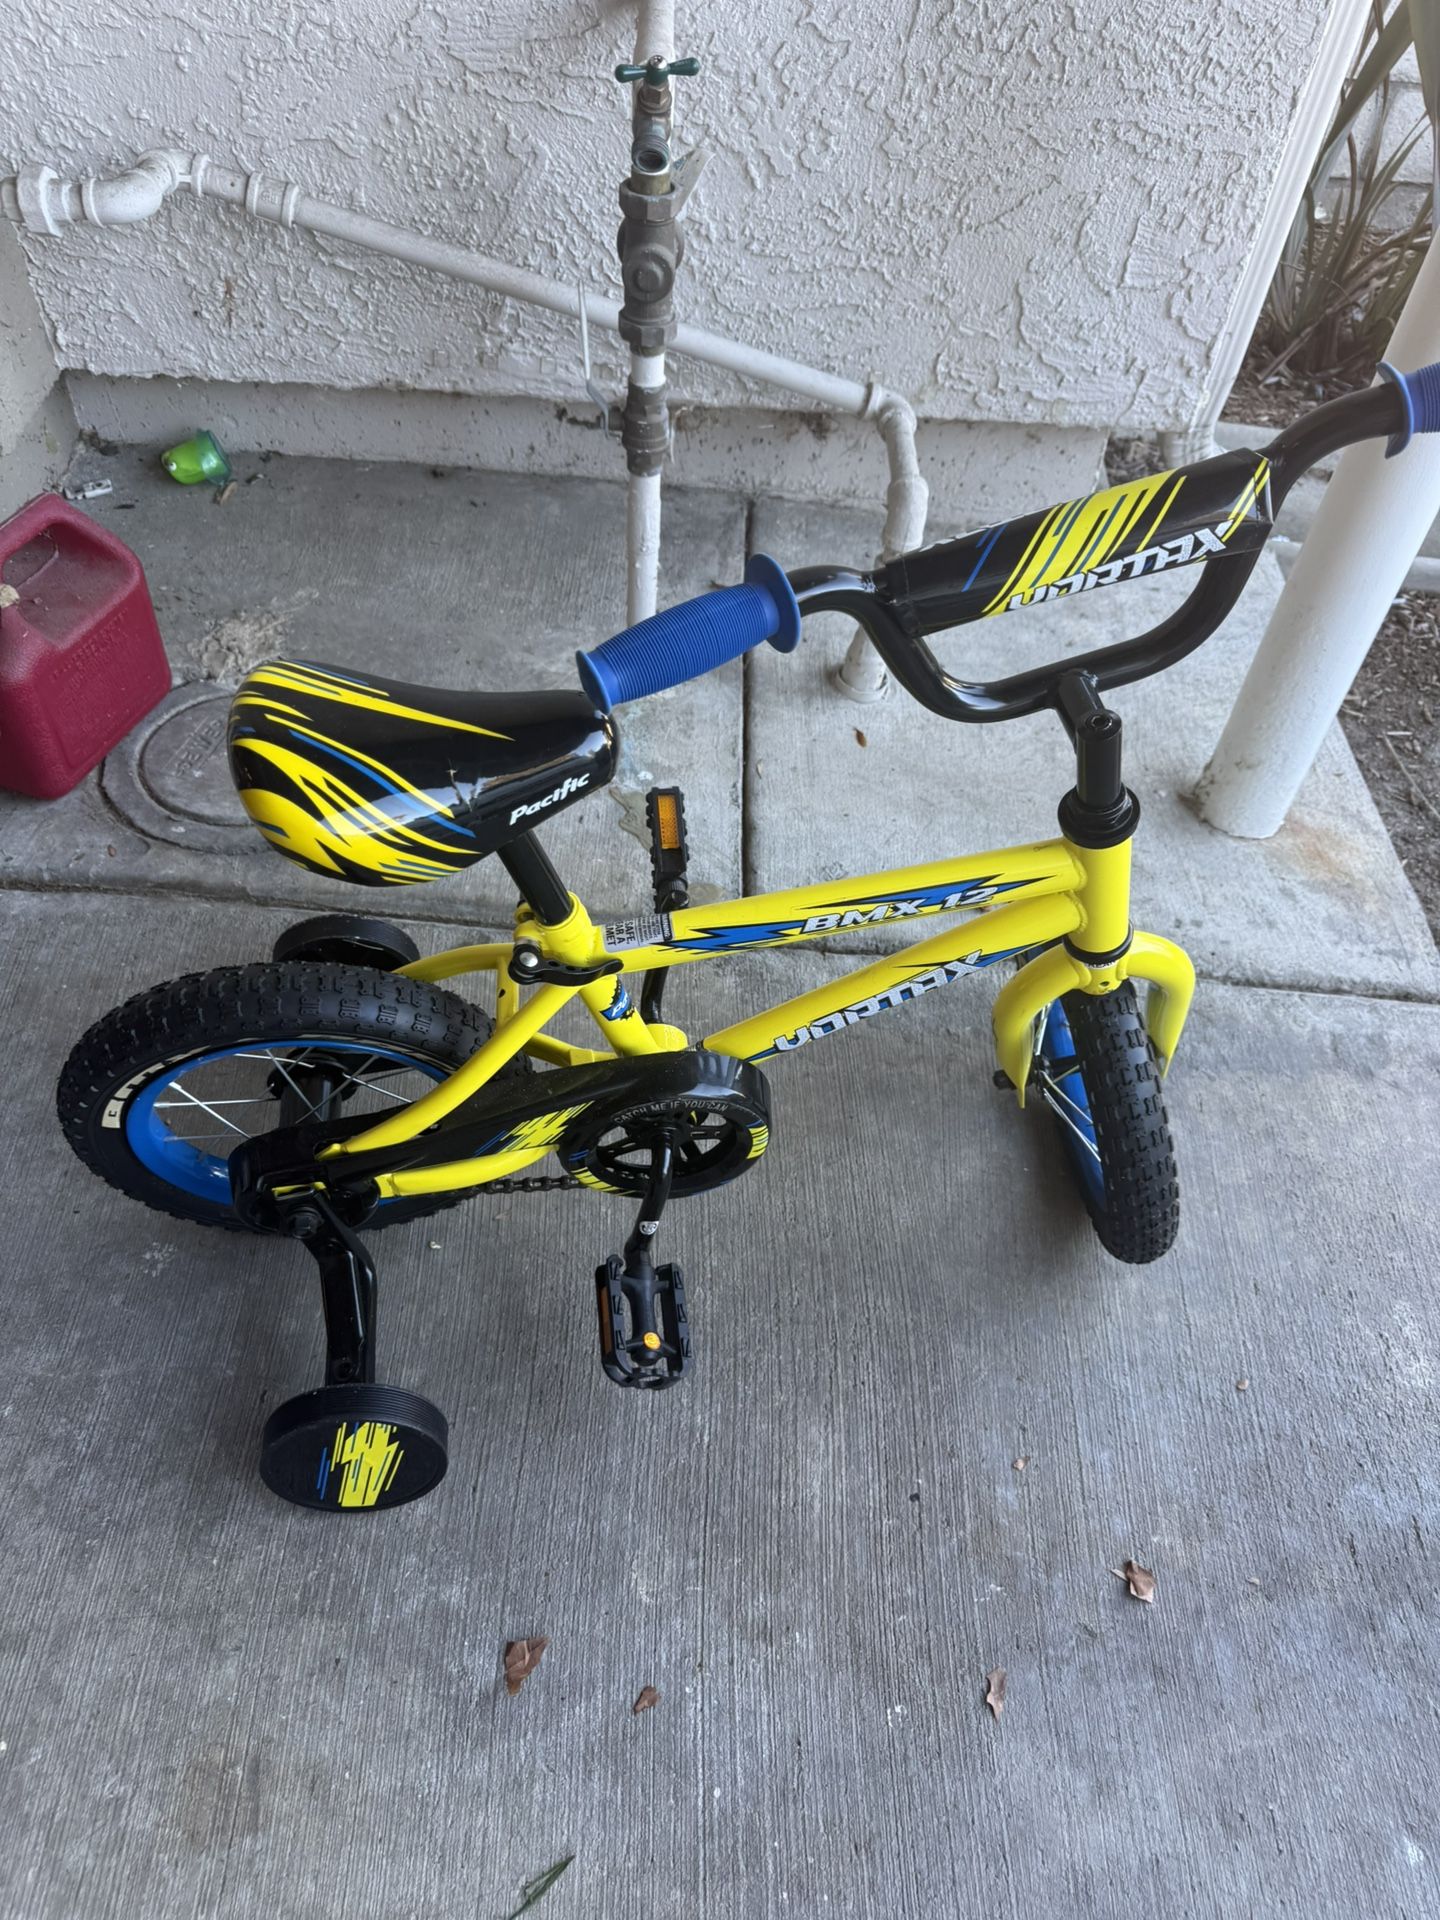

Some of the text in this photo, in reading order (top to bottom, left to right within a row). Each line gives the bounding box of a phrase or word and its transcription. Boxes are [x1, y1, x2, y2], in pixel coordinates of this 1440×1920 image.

[509, 773, 590, 826] Pacific
[803, 887, 998, 933] BMX 12
[614, 1101, 728, 1124] CATCH ME IF YOU CAN
